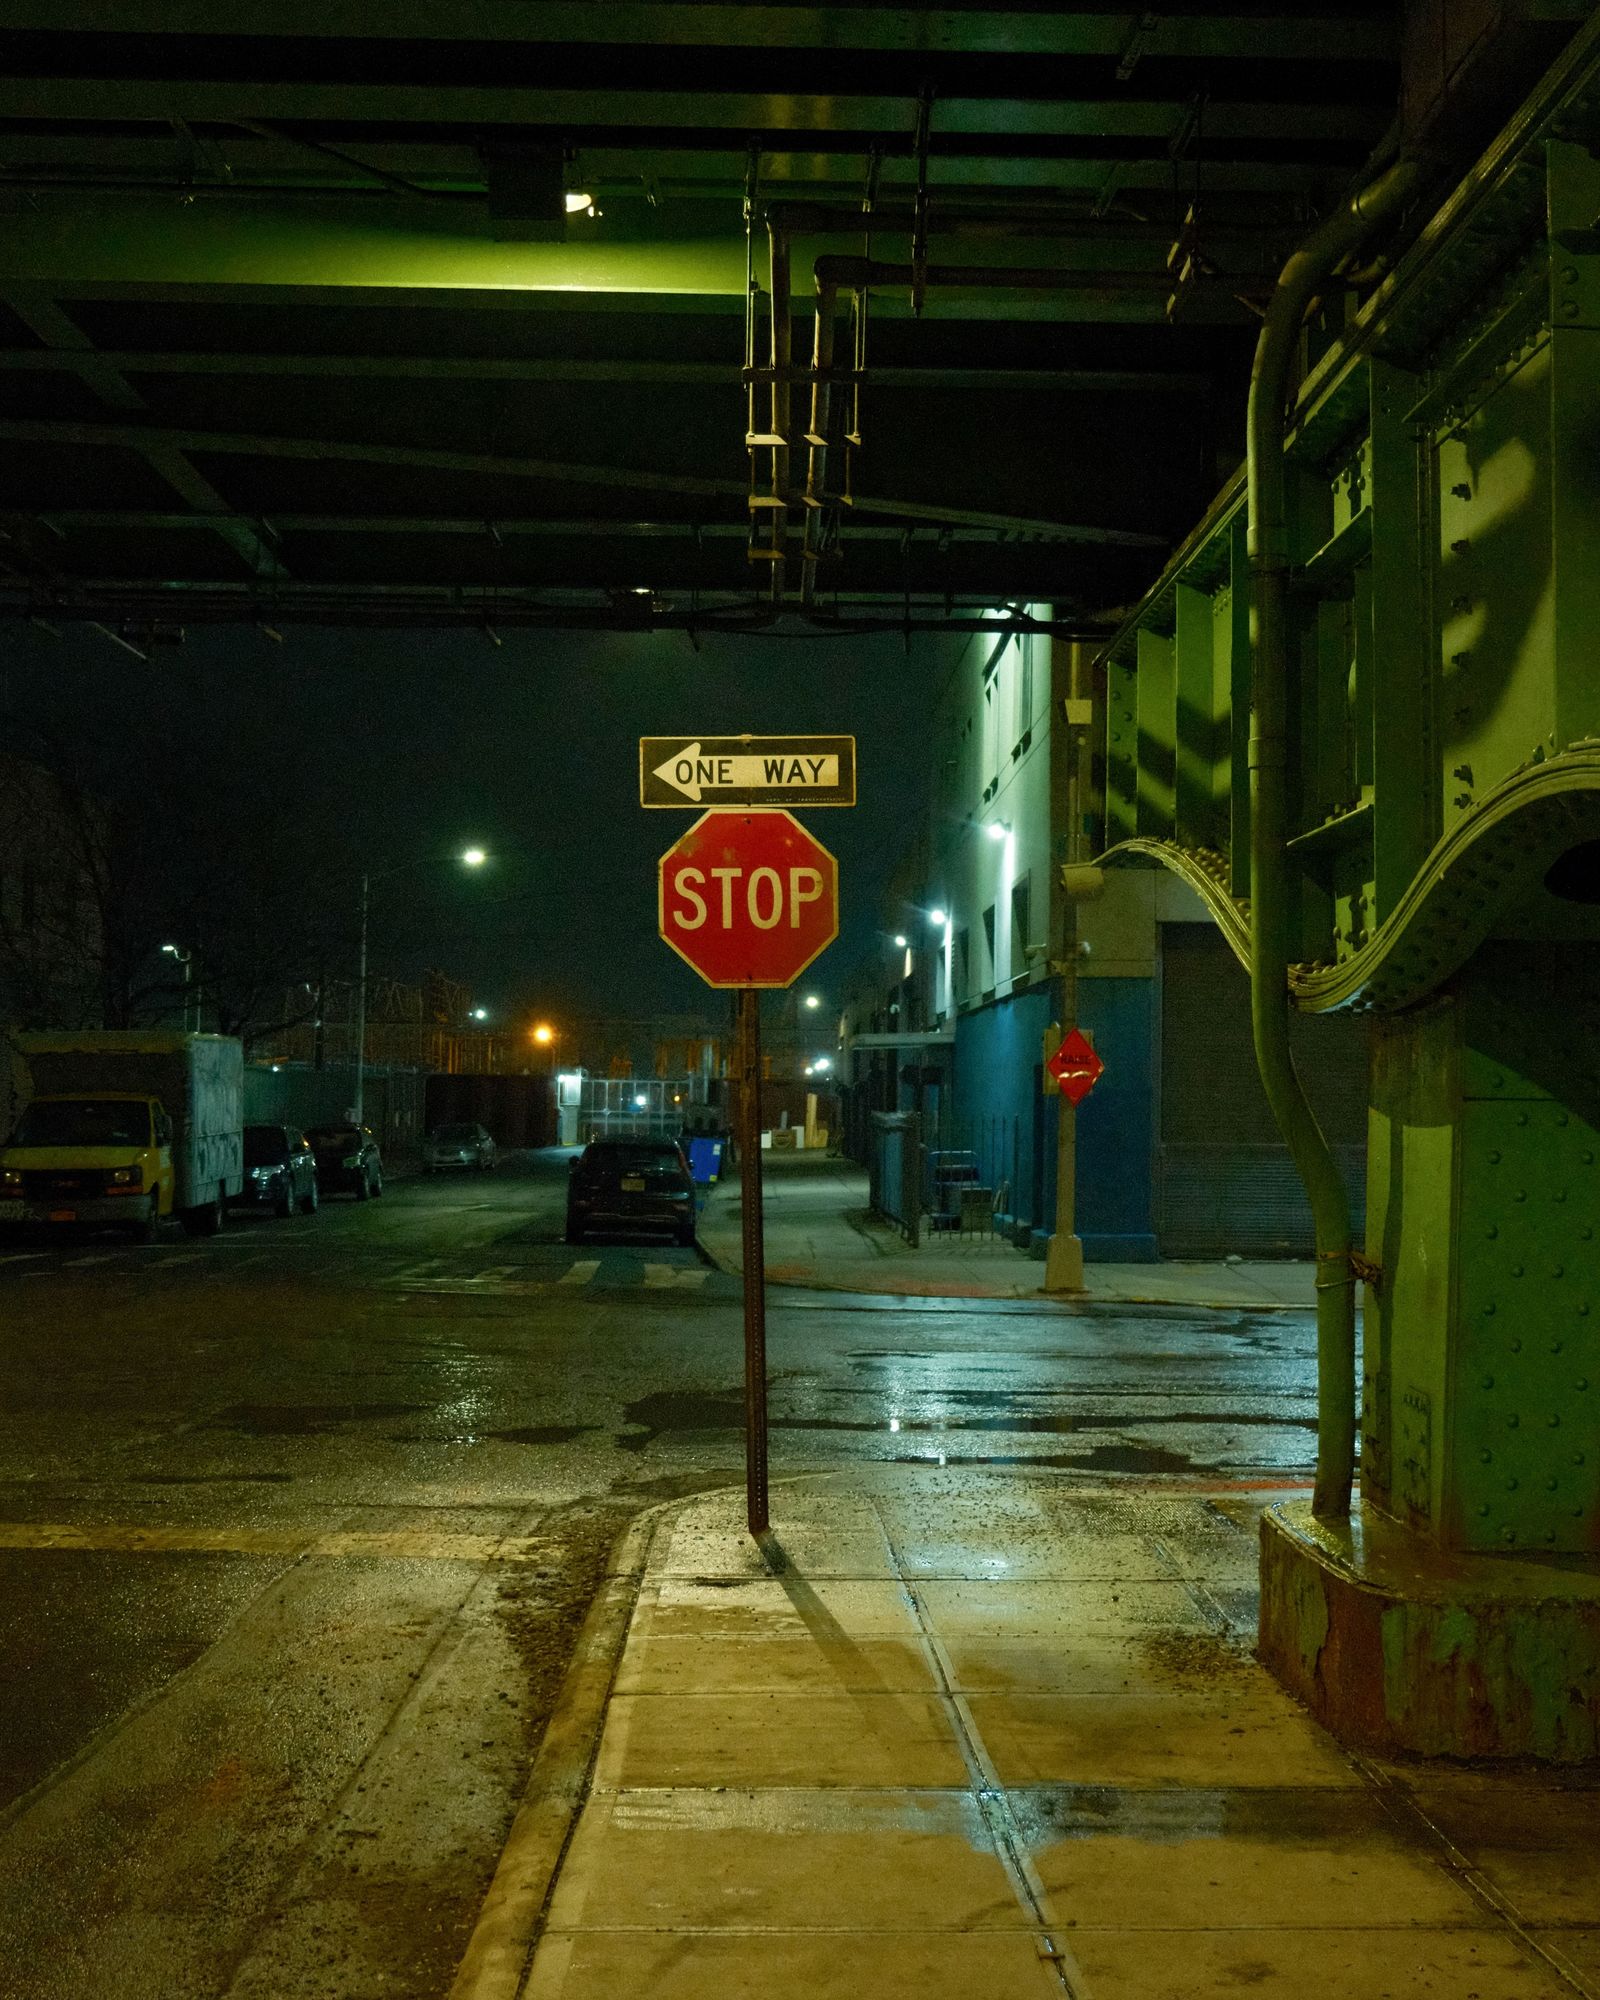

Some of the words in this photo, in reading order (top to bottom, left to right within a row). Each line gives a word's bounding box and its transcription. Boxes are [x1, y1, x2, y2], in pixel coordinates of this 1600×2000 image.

[675, 759, 734, 785] ONE
[763, 759, 826, 784] WAY
[673, 867, 824, 931] STOP
